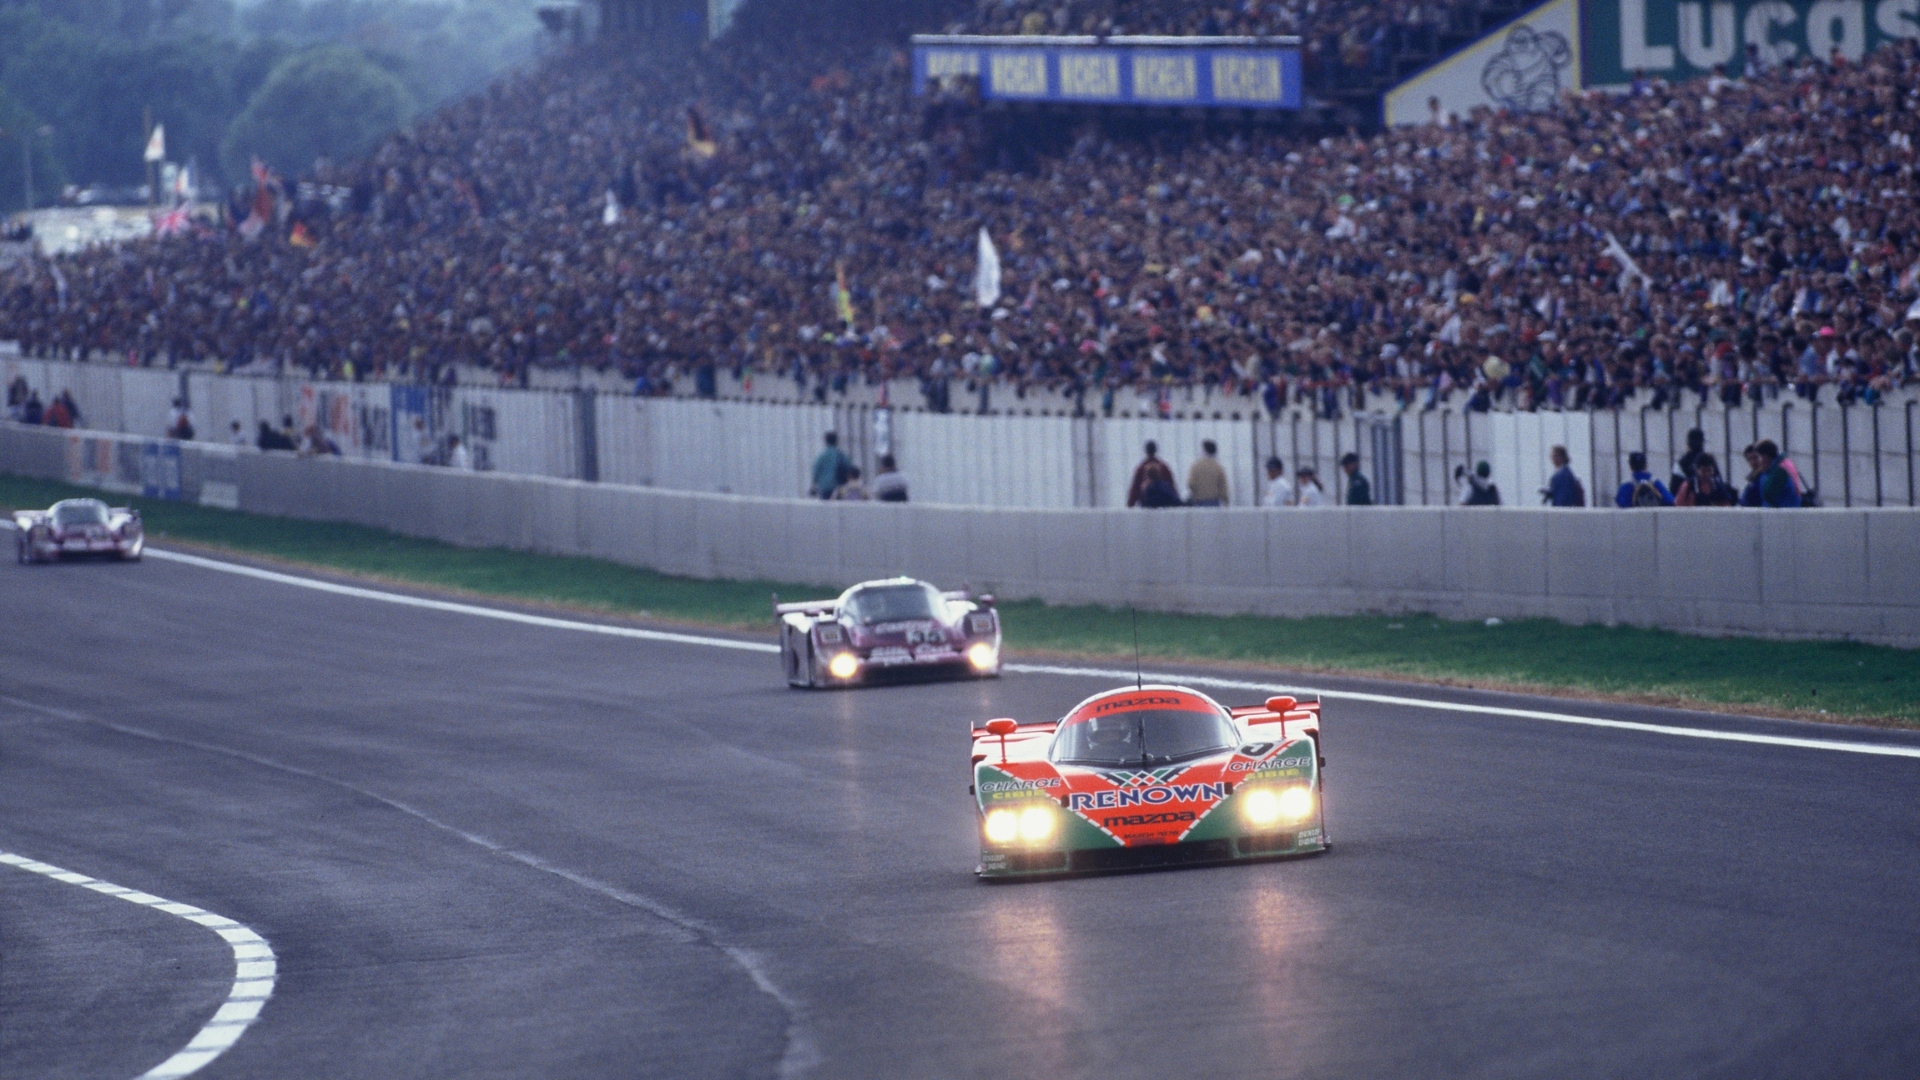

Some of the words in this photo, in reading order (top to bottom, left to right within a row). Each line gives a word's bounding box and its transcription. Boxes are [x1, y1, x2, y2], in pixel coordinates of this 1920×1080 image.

[1229, 757, 1310, 772] CHARGE
[981, 777, 1062, 793] CHARGE
[1070, 781, 1225, 811] RENOWN
